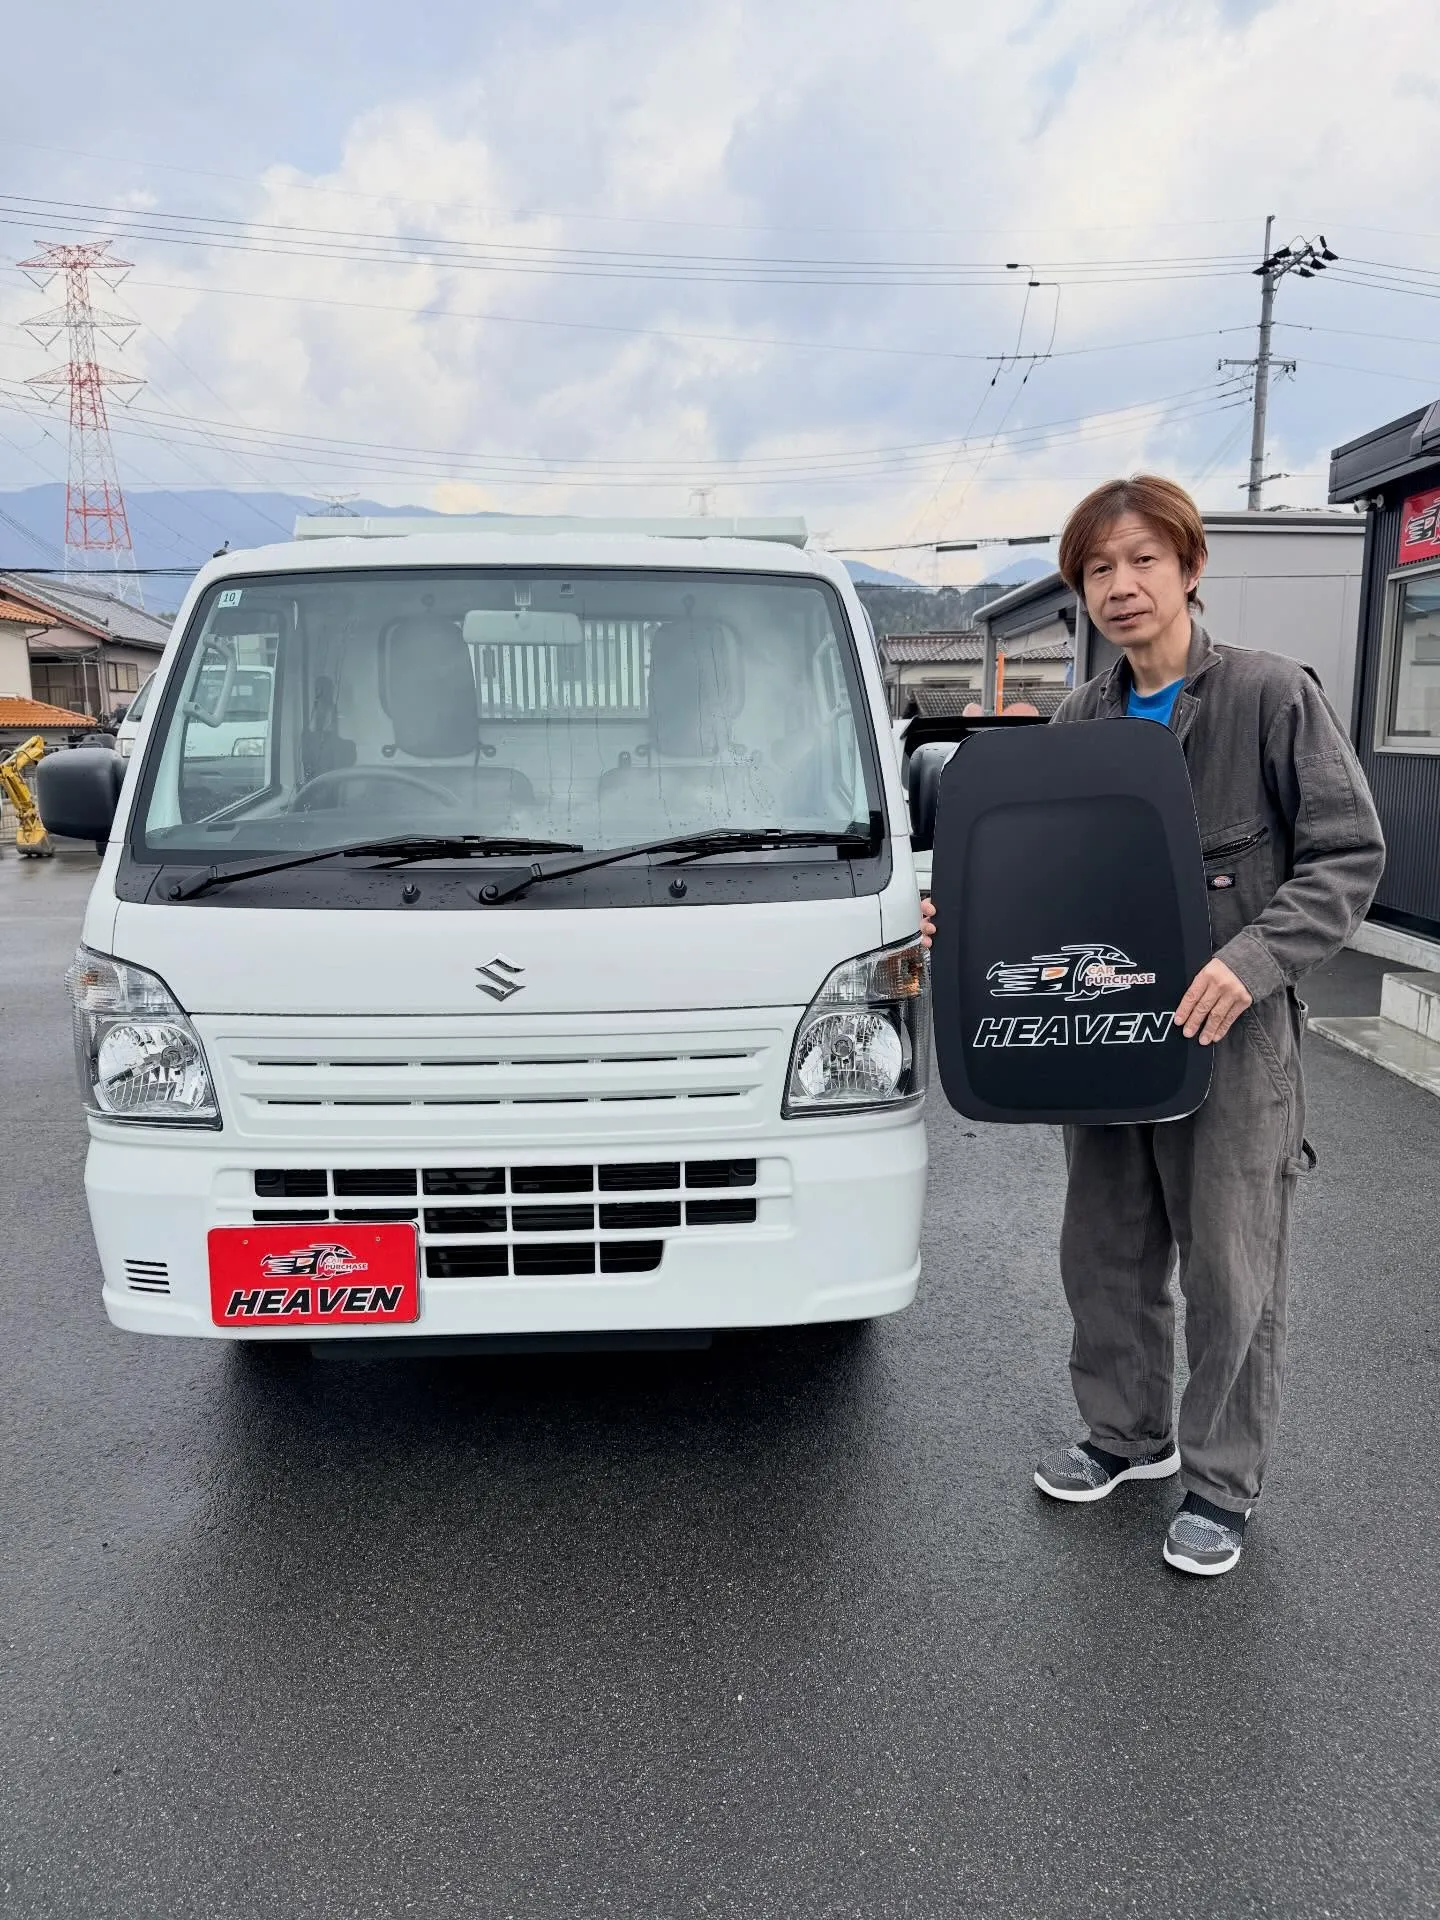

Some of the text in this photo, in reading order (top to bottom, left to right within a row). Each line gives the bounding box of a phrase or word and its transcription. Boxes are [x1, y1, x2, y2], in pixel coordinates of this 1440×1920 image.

[223, 592, 236, 602] 10
[1087, 964, 1114, 975] CAR
[1085, 973, 1155, 986] PURCHASE
[973, 1012, 1176, 1047] HEAVEN
[325, 1262, 368, 1271] PURCHASE
[225, 1285, 403, 1316] HEAVEN
